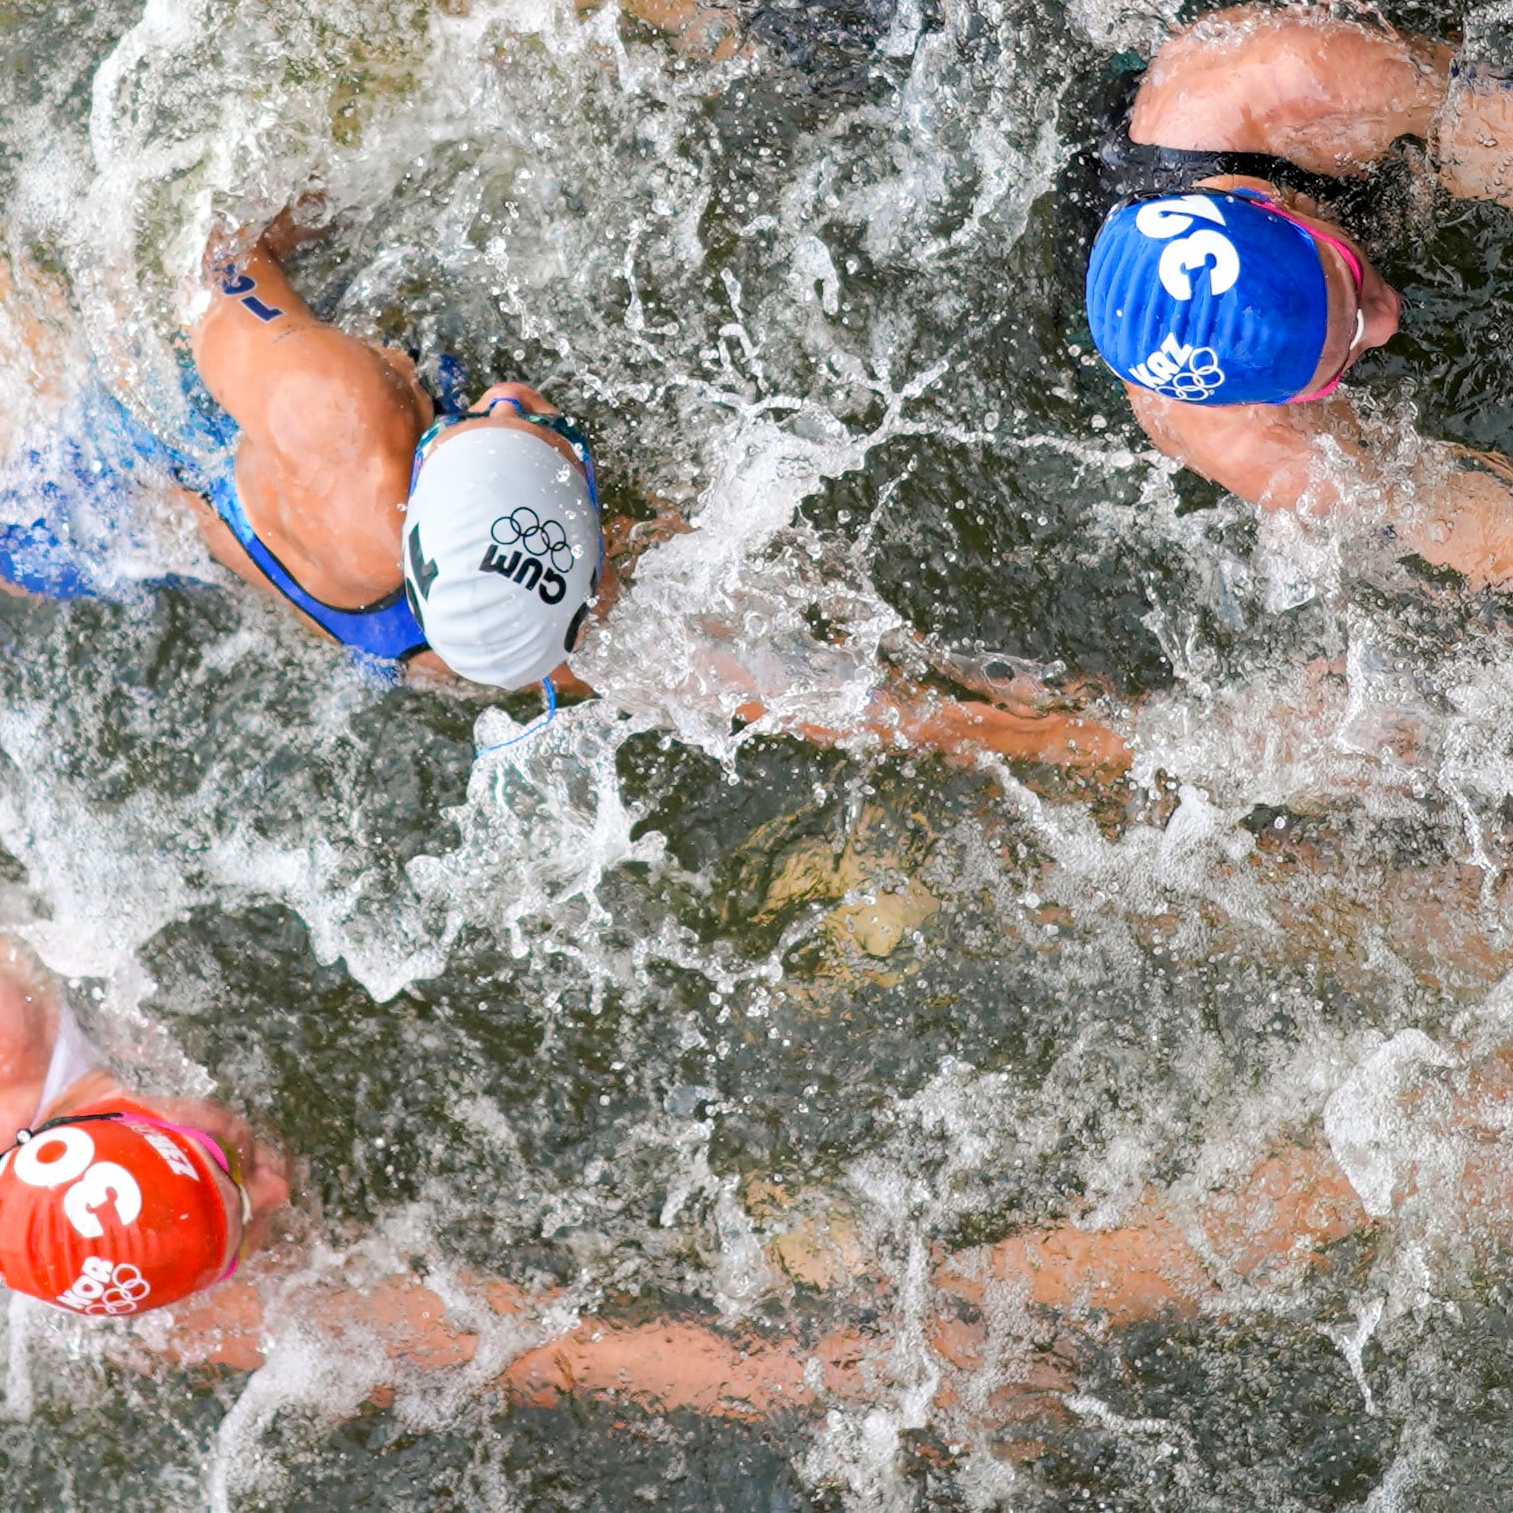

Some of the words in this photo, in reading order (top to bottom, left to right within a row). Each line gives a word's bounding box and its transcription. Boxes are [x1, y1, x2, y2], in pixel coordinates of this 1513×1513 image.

[1136, 194, 1240, 301] 32
[1128, 332, 1193, 388] KAZ
[478, 544, 567, 605] GUM
[13, 1126, 143, 1238] 30
[56, 1255, 115, 1310] NOR
